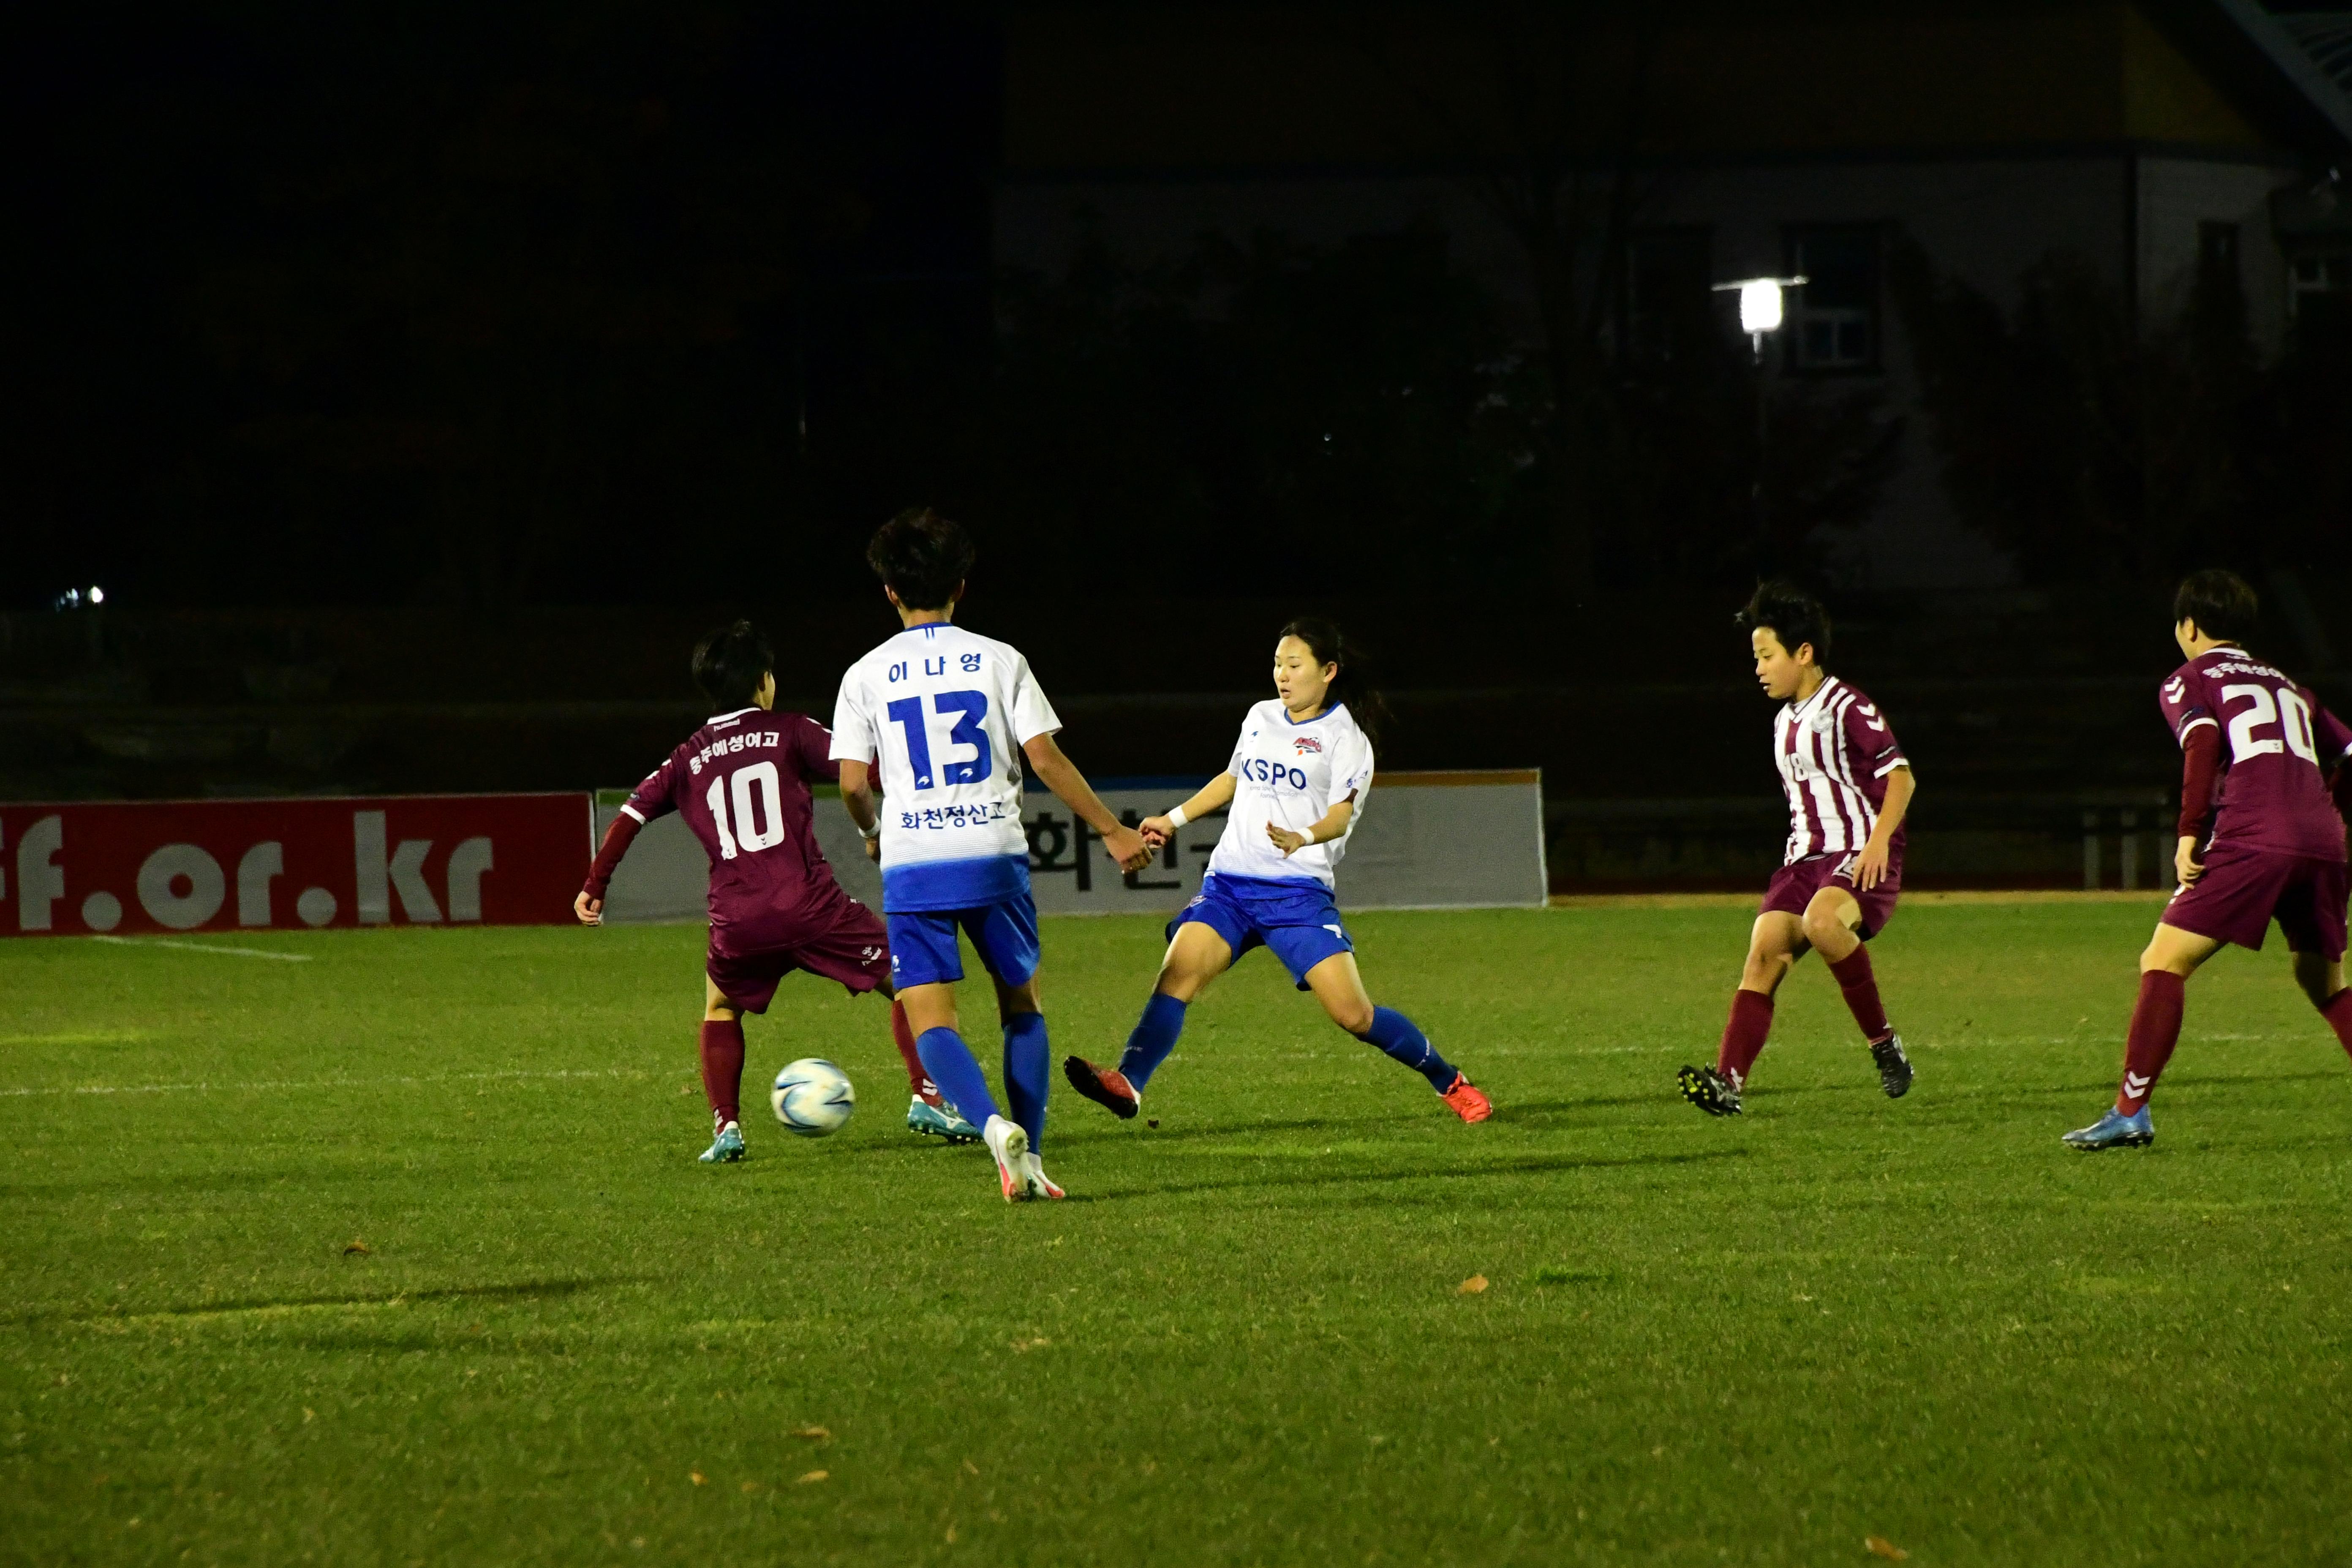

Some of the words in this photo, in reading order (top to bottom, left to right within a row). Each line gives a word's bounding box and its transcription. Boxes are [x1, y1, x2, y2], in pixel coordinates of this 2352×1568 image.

[887, 690, 992, 790] 13
[2221, 684, 2319, 765] 20
[1241, 759, 1307, 790] KSPO
[1783, 752, 1809, 781] 18
[707, 761, 784, 860] 10
[901, 801, 1005, 830] 화천정산고
[0, 809, 494, 930] f.or.kr
